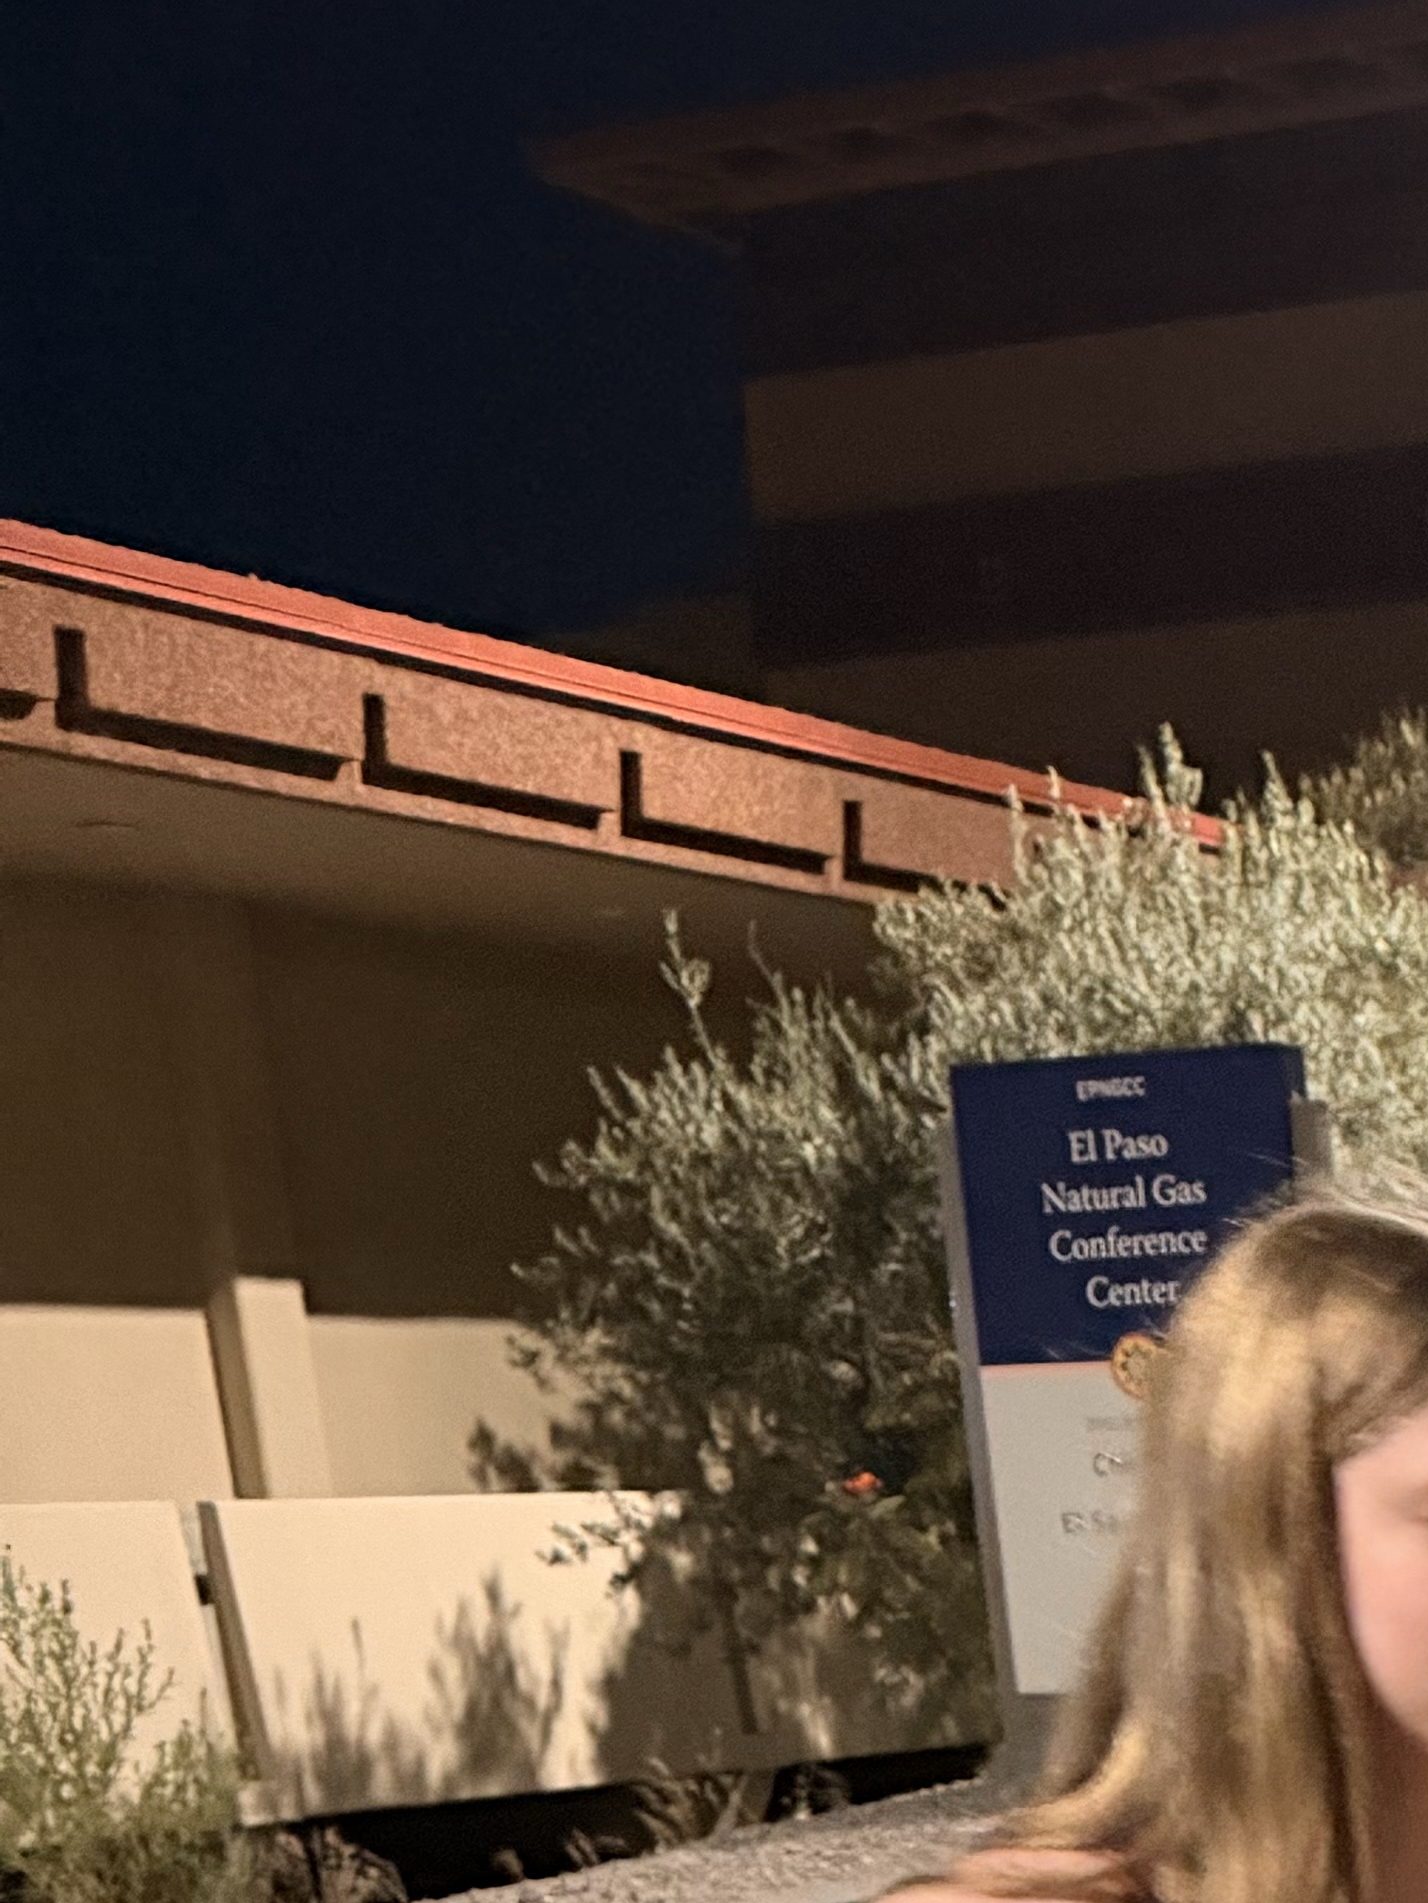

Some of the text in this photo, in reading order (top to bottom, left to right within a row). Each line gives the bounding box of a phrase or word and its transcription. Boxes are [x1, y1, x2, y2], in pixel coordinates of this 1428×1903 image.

[1068, 1128, 1169, 1164] El Paso
[1041, 1173, 1208, 1214] Natural Gas
[1050, 1226, 1208, 1263] Conference
[1086, 1275, 1180, 1309] Center
